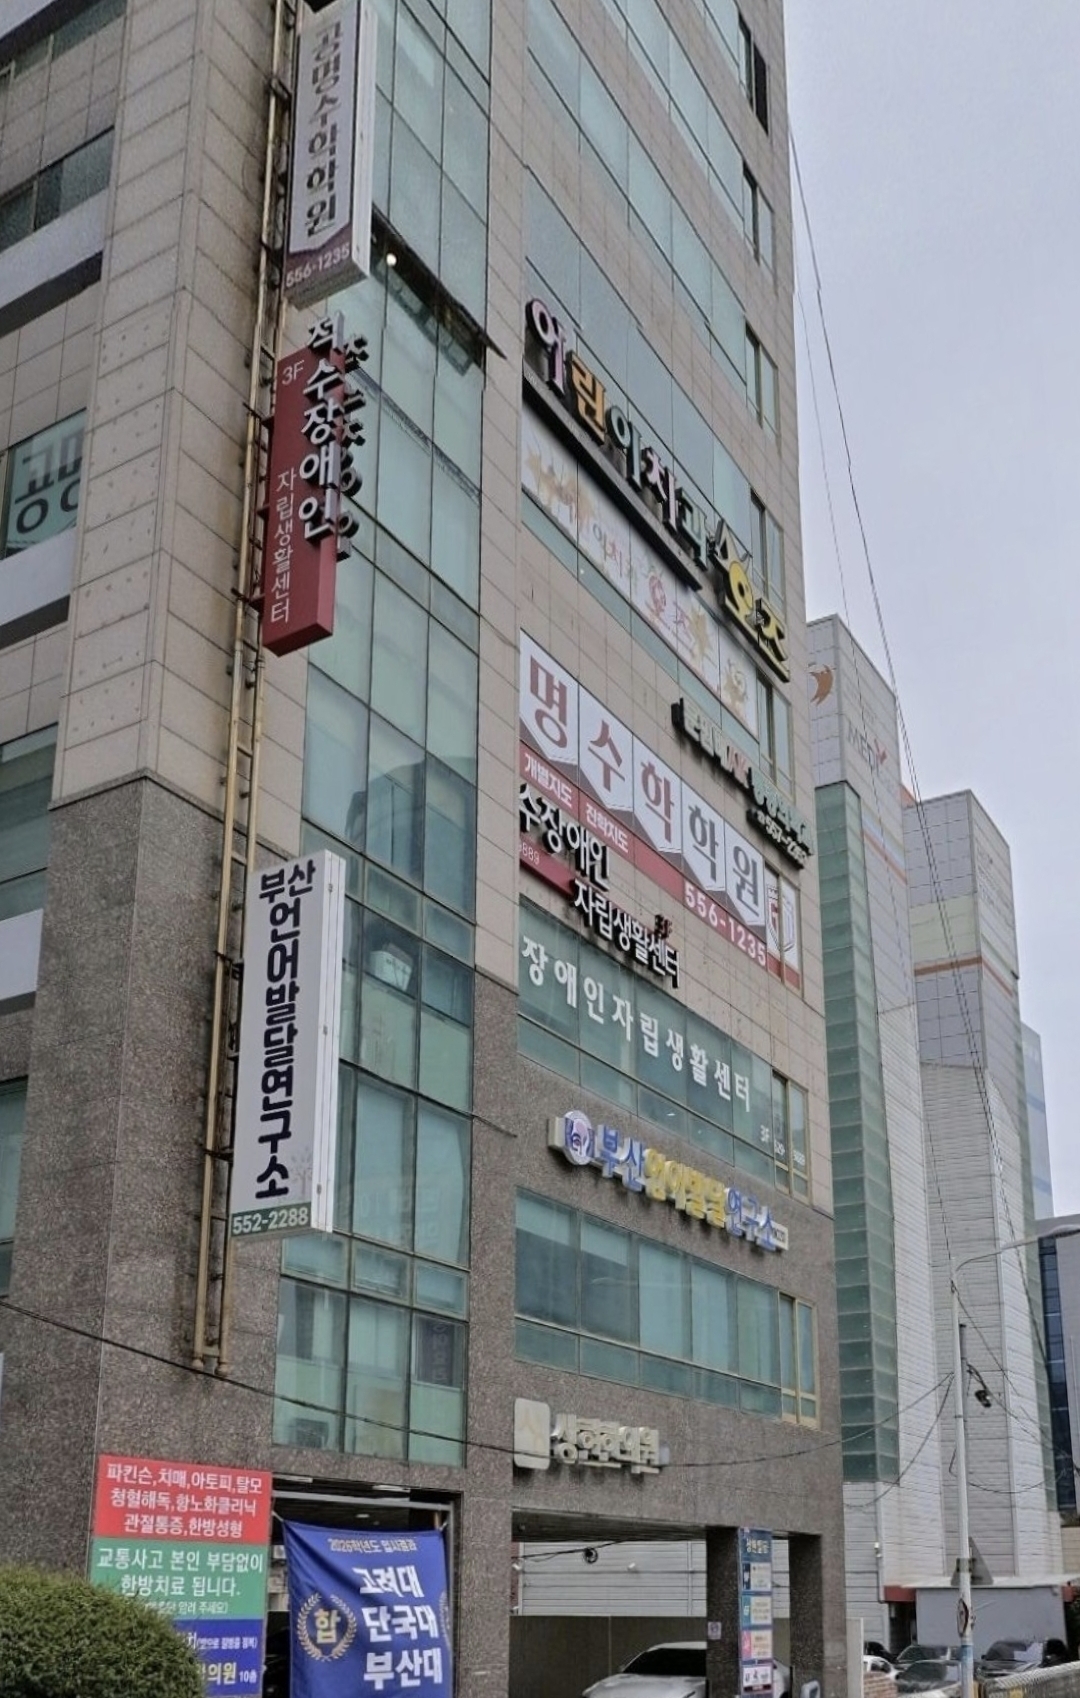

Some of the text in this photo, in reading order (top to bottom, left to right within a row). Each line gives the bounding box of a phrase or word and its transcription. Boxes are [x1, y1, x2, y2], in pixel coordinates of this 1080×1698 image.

[285, 243, 351, 288] 556-1235
[281, 360, 304, 387] 3F
[526, 299, 708, 572] 어린이치과
[270, 466, 298, 623] 자립생활센터
[530, 655, 759, 918] 명수학학원
[574, 878, 679, 989] 자립생활센터
[684, 882, 767, 967] 556-1235
[232, 1207, 309, 1235] 552-2288
[97, 1548, 264, 1573] 교통사고 본인 부담없이
[121, 1574, 241, 1597] 한방치료 됩니다.
[352, 1565, 424, 1598] 고려대
[314, 1608, 341, 1644] 합
[361, 1604, 439, 1643] 단국대
[363, 1647, 443, 1691] 부산대
